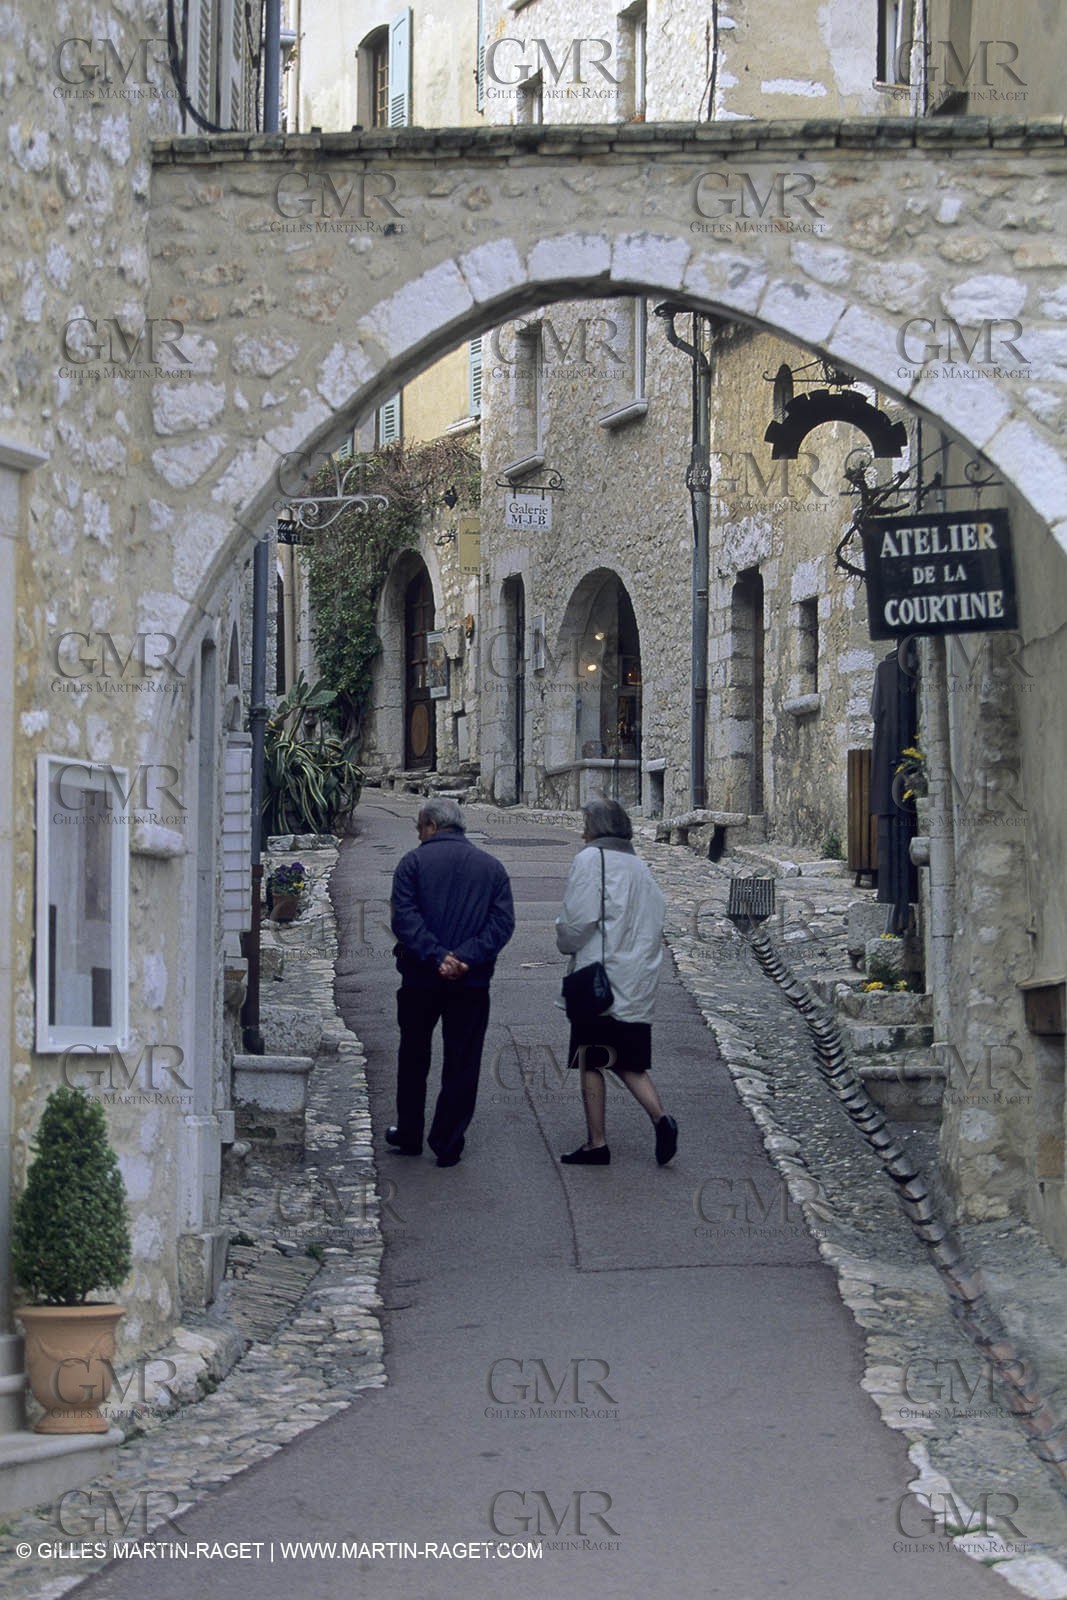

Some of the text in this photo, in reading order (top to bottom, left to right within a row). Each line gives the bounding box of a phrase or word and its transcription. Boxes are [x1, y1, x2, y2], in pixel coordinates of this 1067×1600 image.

[509, 502, 548, 515] Galerie
[511, 514, 546, 525] M-J-B
[880, 523, 998, 558] ATELIER
[912, 564, 967, 584] DE LA
[884, 590, 1004, 626] COURTINE
